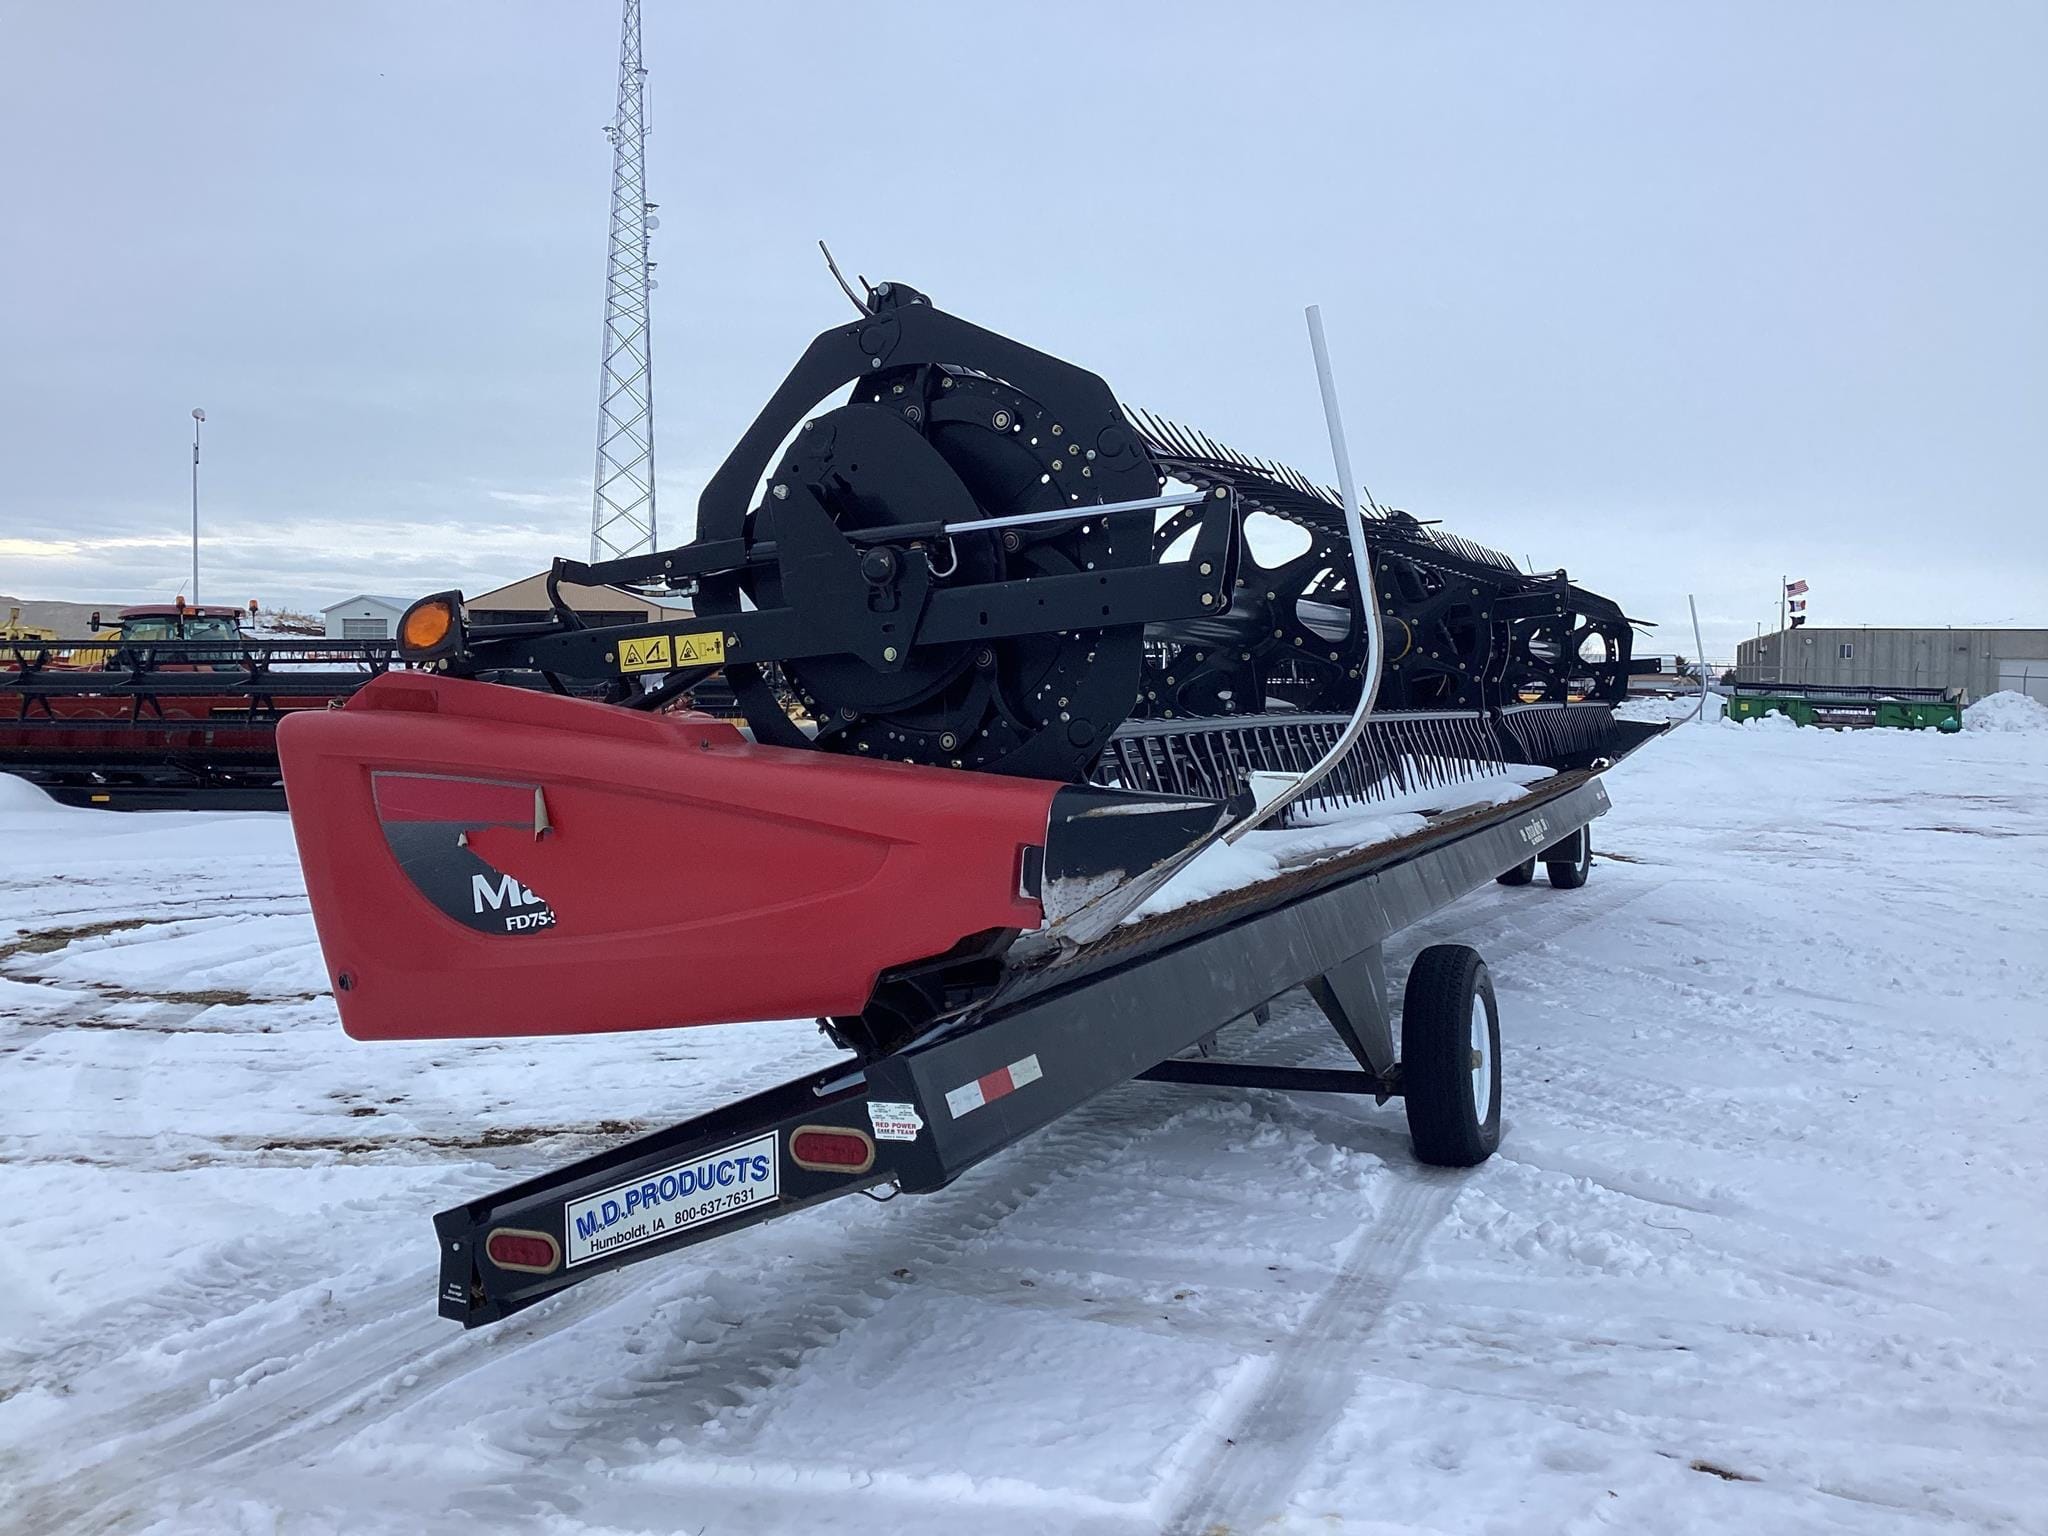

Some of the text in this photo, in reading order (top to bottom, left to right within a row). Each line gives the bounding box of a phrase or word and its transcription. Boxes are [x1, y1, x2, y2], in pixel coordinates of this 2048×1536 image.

[590, 1187, 755, 1252] Humboldt, IA 800-637-7631
